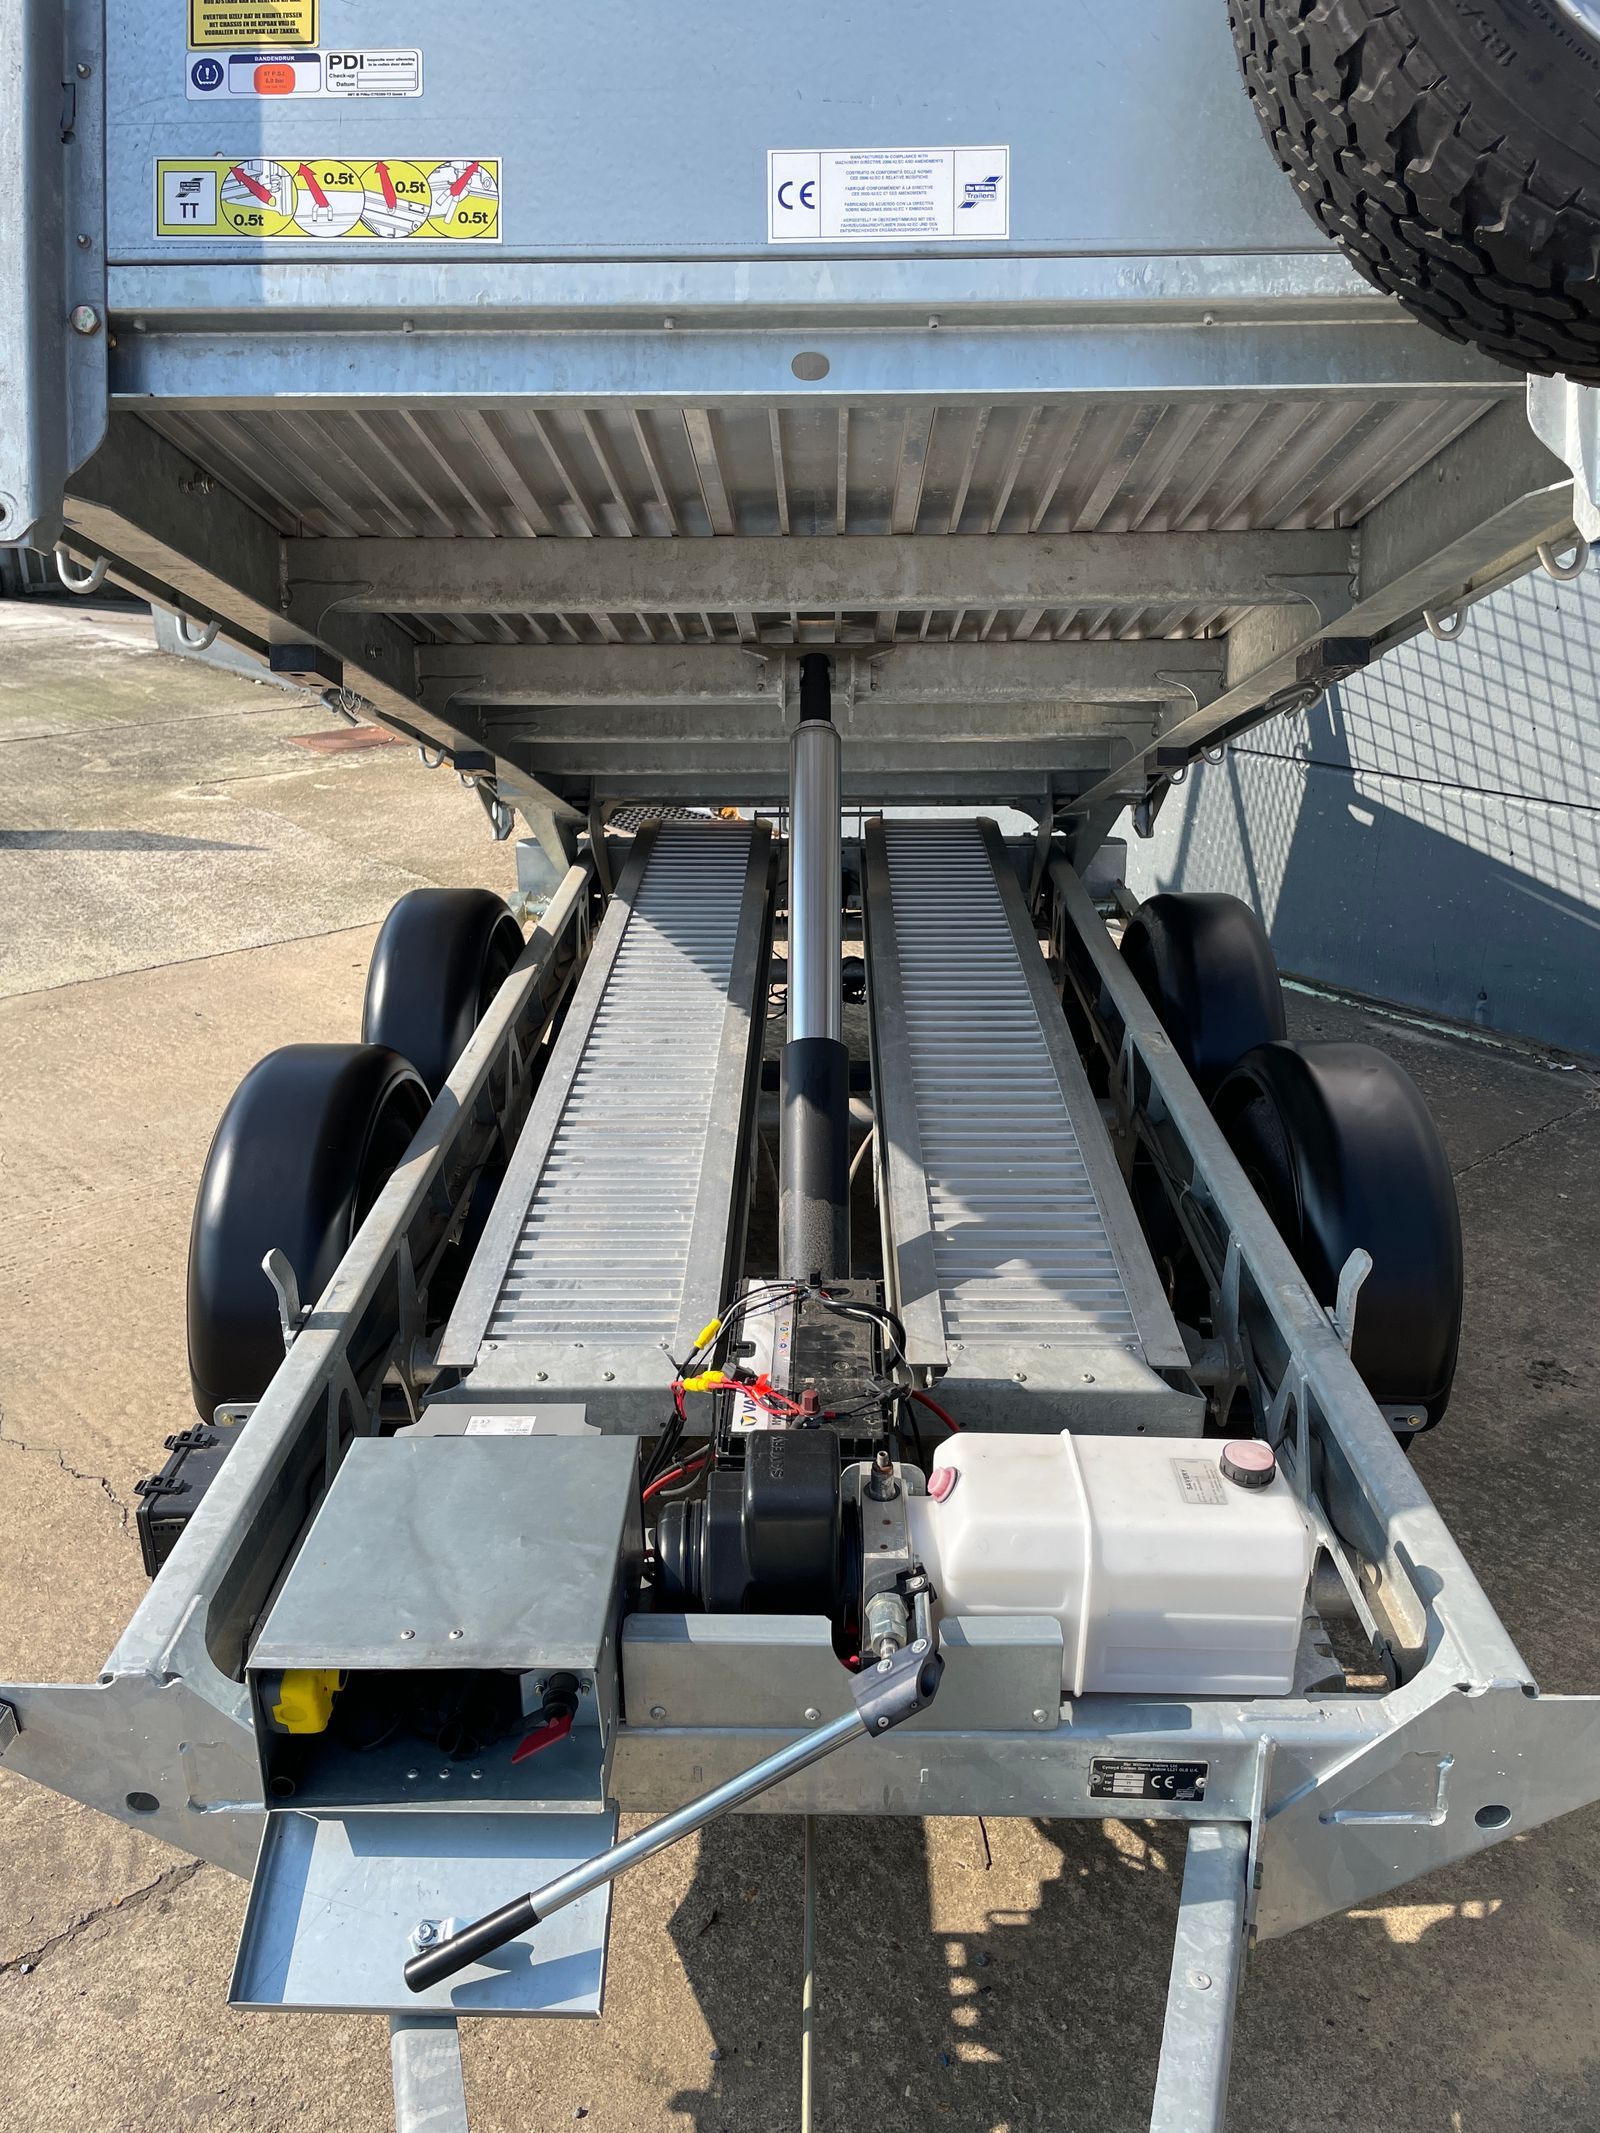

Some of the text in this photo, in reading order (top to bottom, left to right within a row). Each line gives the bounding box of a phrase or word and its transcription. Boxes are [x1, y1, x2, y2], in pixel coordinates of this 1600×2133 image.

[329, 55, 364, 70] PDI
[324, 173, 354, 184] 0.5t
[395, 182, 425, 193] 0.5t
[778, 180, 815, 210] CE
[180, 203, 199, 218] TT
[234, 214, 264, 226] 0.5t
[458, 212, 488, 224] 0.5t
[770, 1436, 784, 1478] SAVERY
[1151, 1776, 1174, 1789] CE
